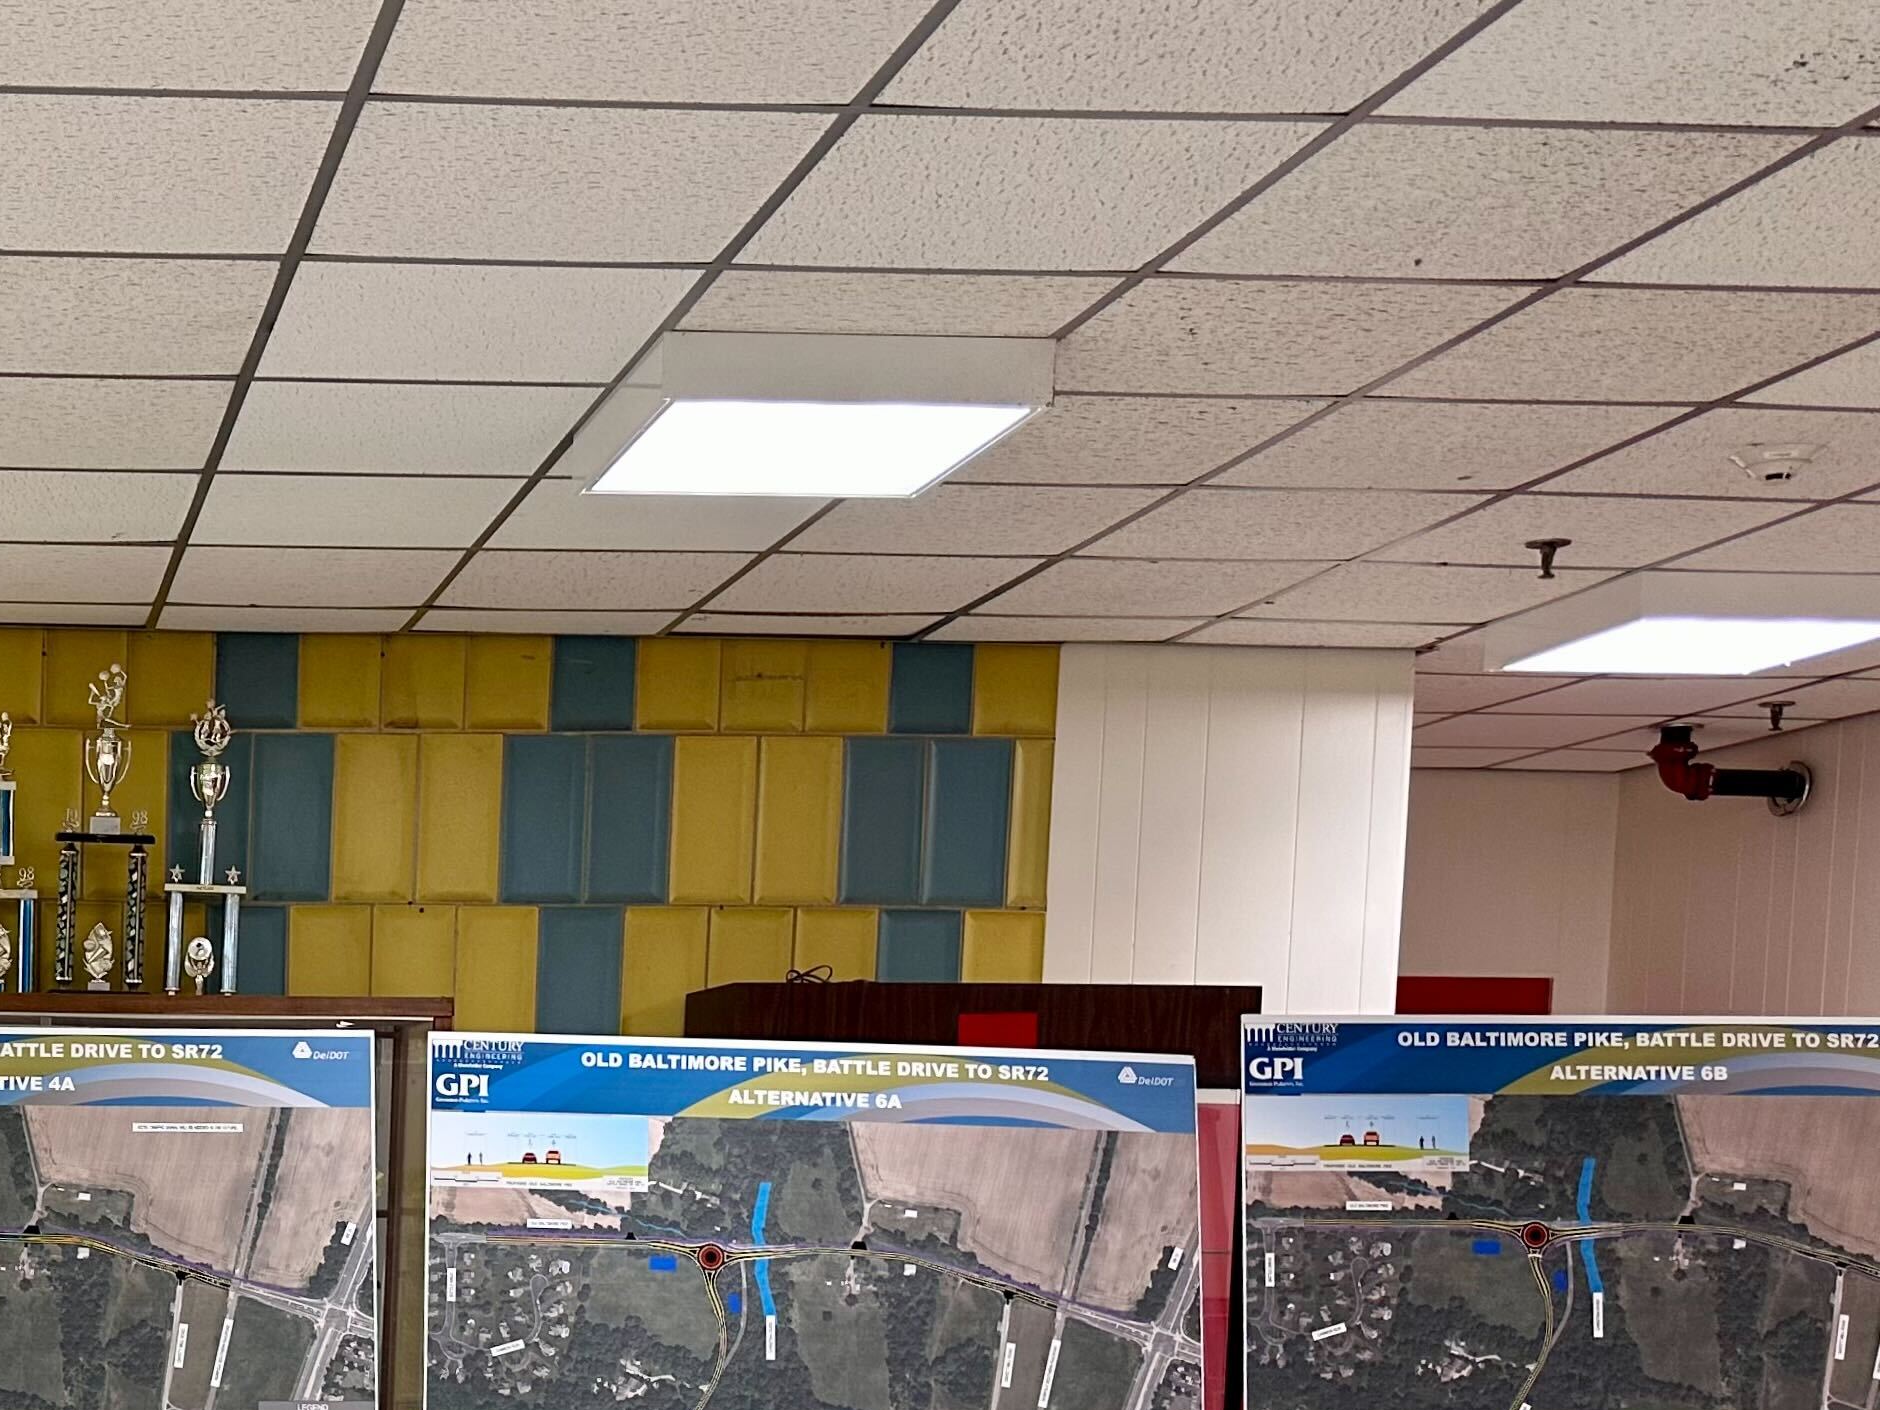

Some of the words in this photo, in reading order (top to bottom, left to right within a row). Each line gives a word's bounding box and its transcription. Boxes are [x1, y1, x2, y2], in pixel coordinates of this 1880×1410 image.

[1276, 1023, 1338, 1034] CENTURY
[463, 1040, 525, 1052] CENTURY
[1277, 1035, 1337, 1043] ENGINEERING
[1398, 1032, 1440, 1046] OLD
[1447, 1032, 1568, 1047] BALTIMORE
[1575, 1032, 1629, 1050] PIKE,
[1636, 1033, 1715, 1047] BATTLE
[1723, 1033, 1785, 1048] DRIVE
[1792, 1033, 1820, 1048] TO
[1826, 1034, 1879, 1048] SR72
[71, 1044, 132, 1058] DRIVE
[138, 1044, 166, 1059] TO
[172, 1044, 222, 1059] SR72
[464, 1053, 523, 1061] ENGINEERING
[581, 1052, 622, 1067] OLD
[629, 1053, 746, 1071] BALTIMORE
[753, 1057, 807, 1076] PIKE,
[813, 1059, 891, 1076] BATTLE
[898, 1062, 958, 1078] DRIVE
[964, 1064, 992, 1079] TO
[998, 1065, 1049, 1081] SR72
[1249, 1057, 1304, 1080] GPI
[1550, 1066, 1695, 1080] ALTERNATIVE
[1701, 1066, 1728, 1080] 6B
[49, 1077, 75, 1091] 4A
[435, 1073, 489, 1097] GPI
[729, 1089, 869, 1108] ALTERNATIVE
[875, 1094, 902, 1109] 6A
